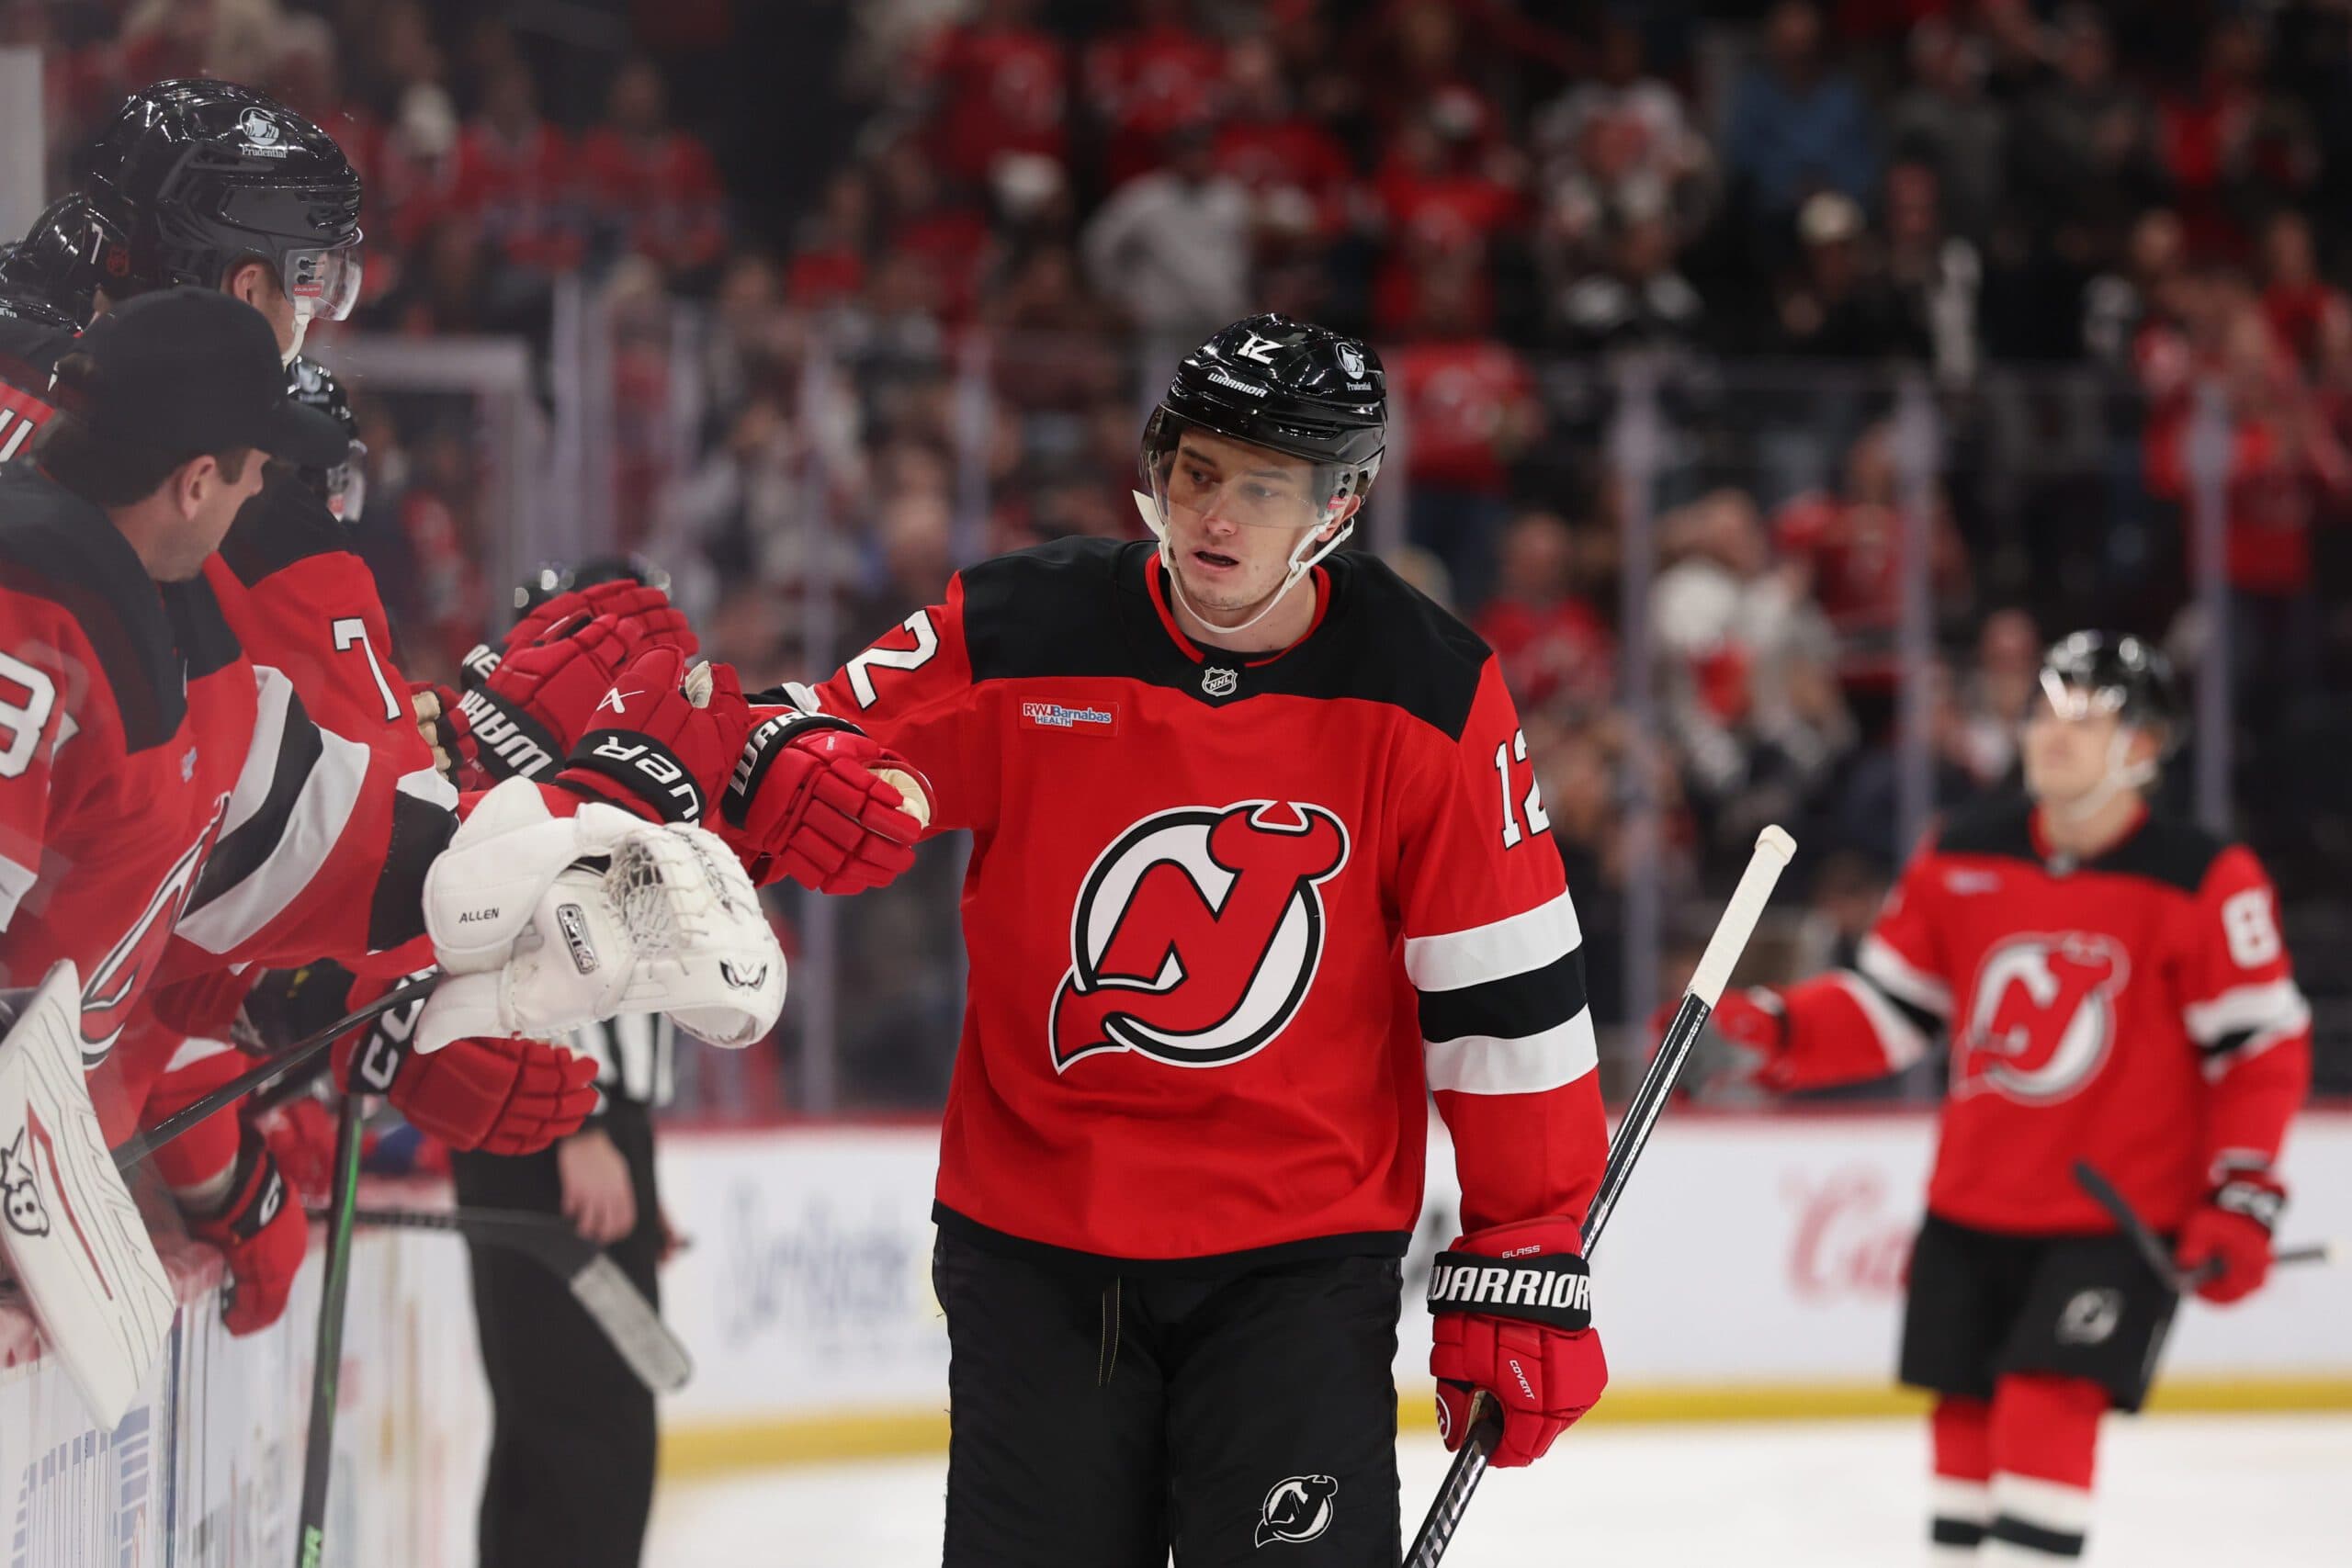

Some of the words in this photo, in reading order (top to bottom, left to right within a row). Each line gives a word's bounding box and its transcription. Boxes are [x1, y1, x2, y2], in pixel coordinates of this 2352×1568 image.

[243, 145, 288, 158] Prudential
[90, 221, 104, 265] 7
[1237, 336, 1284, 365] 12
[1207, 372, 1268, 398] WARRIOR
[1347, 381, 1373, 391] Prudential
[332, 616, 402, 722] 7
[1035, 716, 1073, 728] HEALTH
[1495, 728, 1550, 851] 12
[458, 907, 500, 924] ALLEN
[1501, 1245, 1542, 1259] GLASS
[1427, 1265, 1591, 1311] WARRIOR
[1509, 1359, 1536, 1400] COVERT
